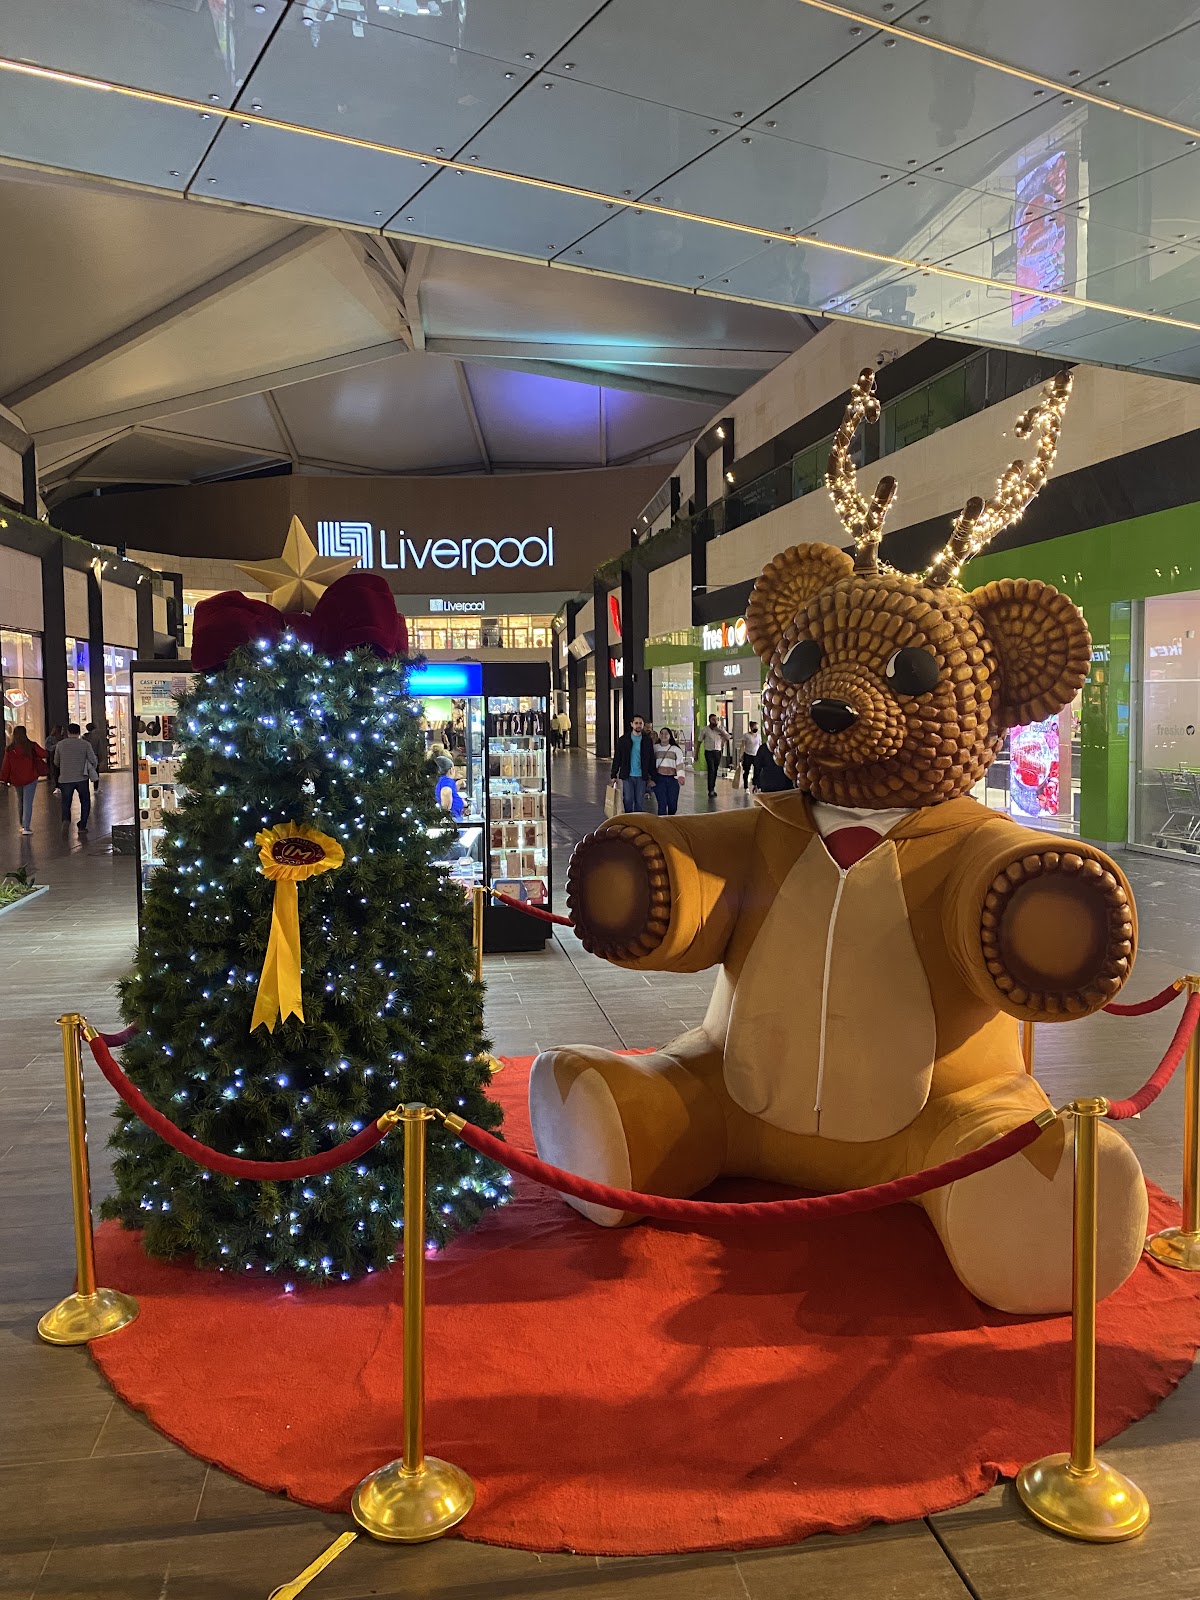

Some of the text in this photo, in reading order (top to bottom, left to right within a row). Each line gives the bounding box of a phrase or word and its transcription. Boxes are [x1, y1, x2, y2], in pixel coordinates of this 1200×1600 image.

[379, 527, 554, 576] Liverpool
[443, 600, 485, 612] Liverpool
[703, 621, 735, 651] fresko
[1156, 724, 1185, 736] fresko
